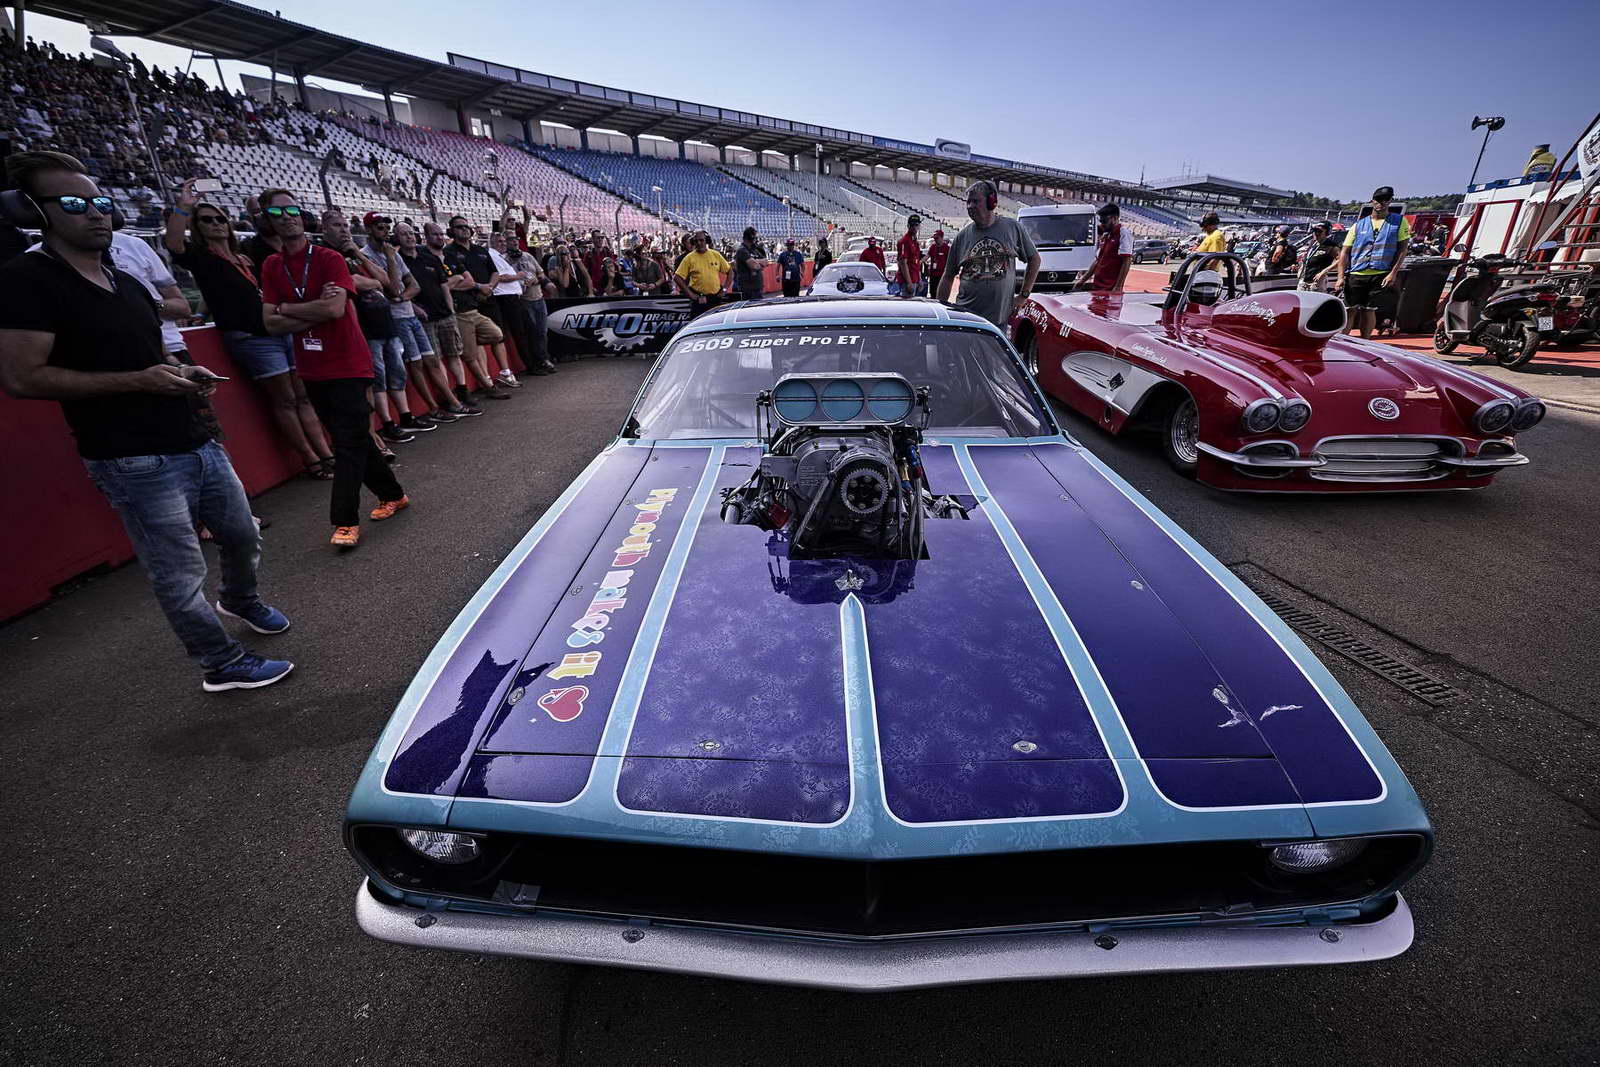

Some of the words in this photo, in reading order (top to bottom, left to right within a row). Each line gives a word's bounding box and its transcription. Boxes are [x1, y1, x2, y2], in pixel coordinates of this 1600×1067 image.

[643, 312, 674, 322] DRAG
[679, 337, 734, 354] 2609
[738, 338, 793, 349] Super
[798, 336, 834, 345] Pro
[837, 335, 861, 344] ET
[566, 569, 634, 648] makes
